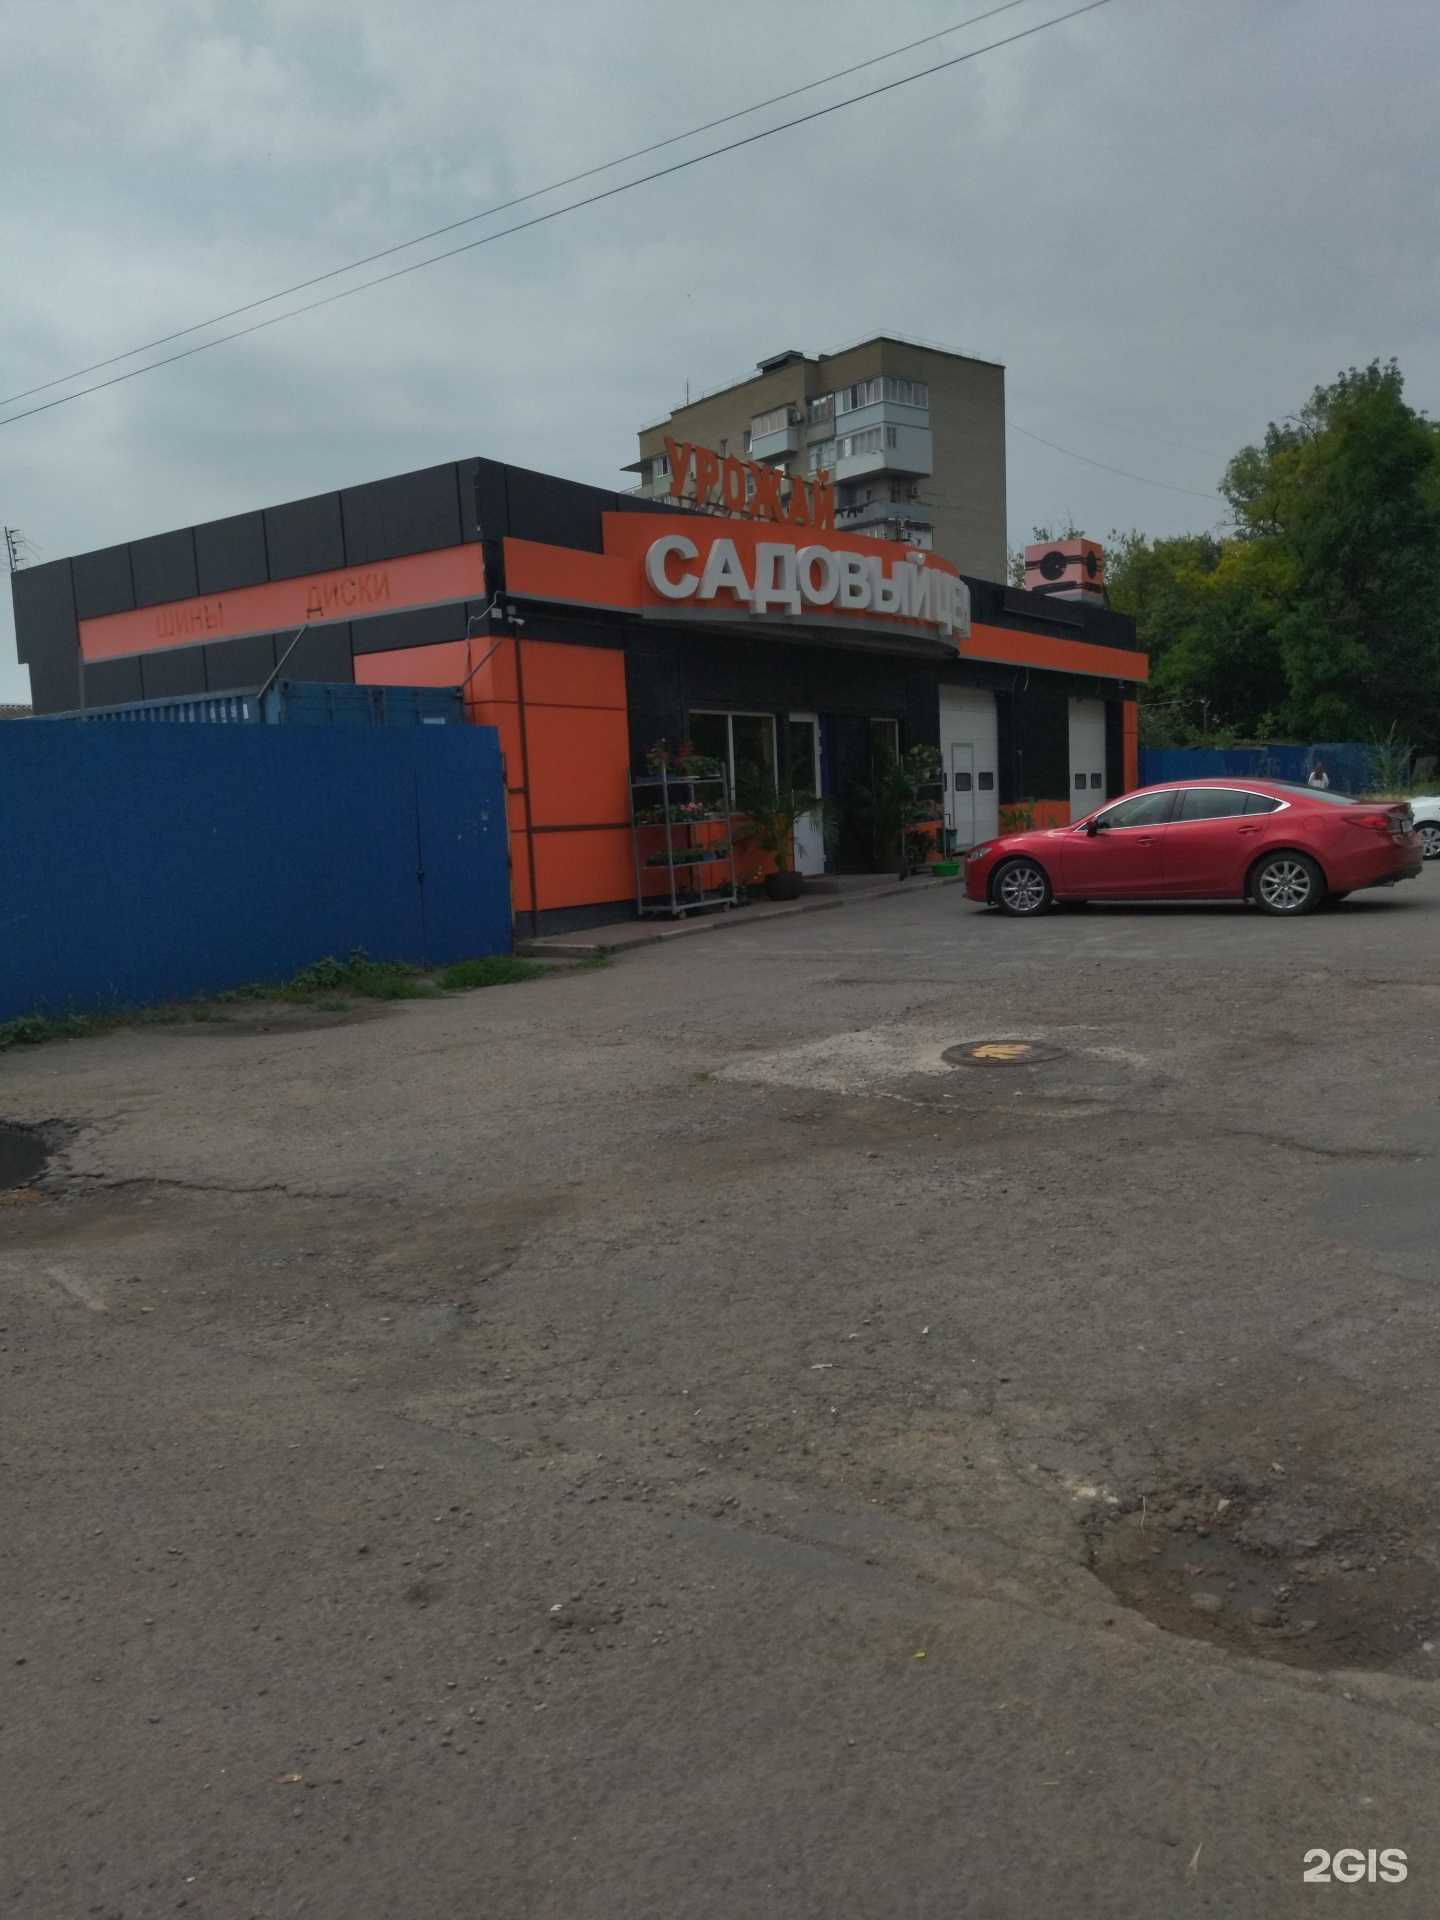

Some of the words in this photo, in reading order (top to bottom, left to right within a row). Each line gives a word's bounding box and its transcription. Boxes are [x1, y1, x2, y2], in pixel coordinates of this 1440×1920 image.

[664, 437, 836, 530] УРОЖАЙ
[156, 601, 224, 638] ШИНЫ
[306, 572, 390, 619] ДИСКИ
[646, 534, 931, 616] САДОВЫЙ
